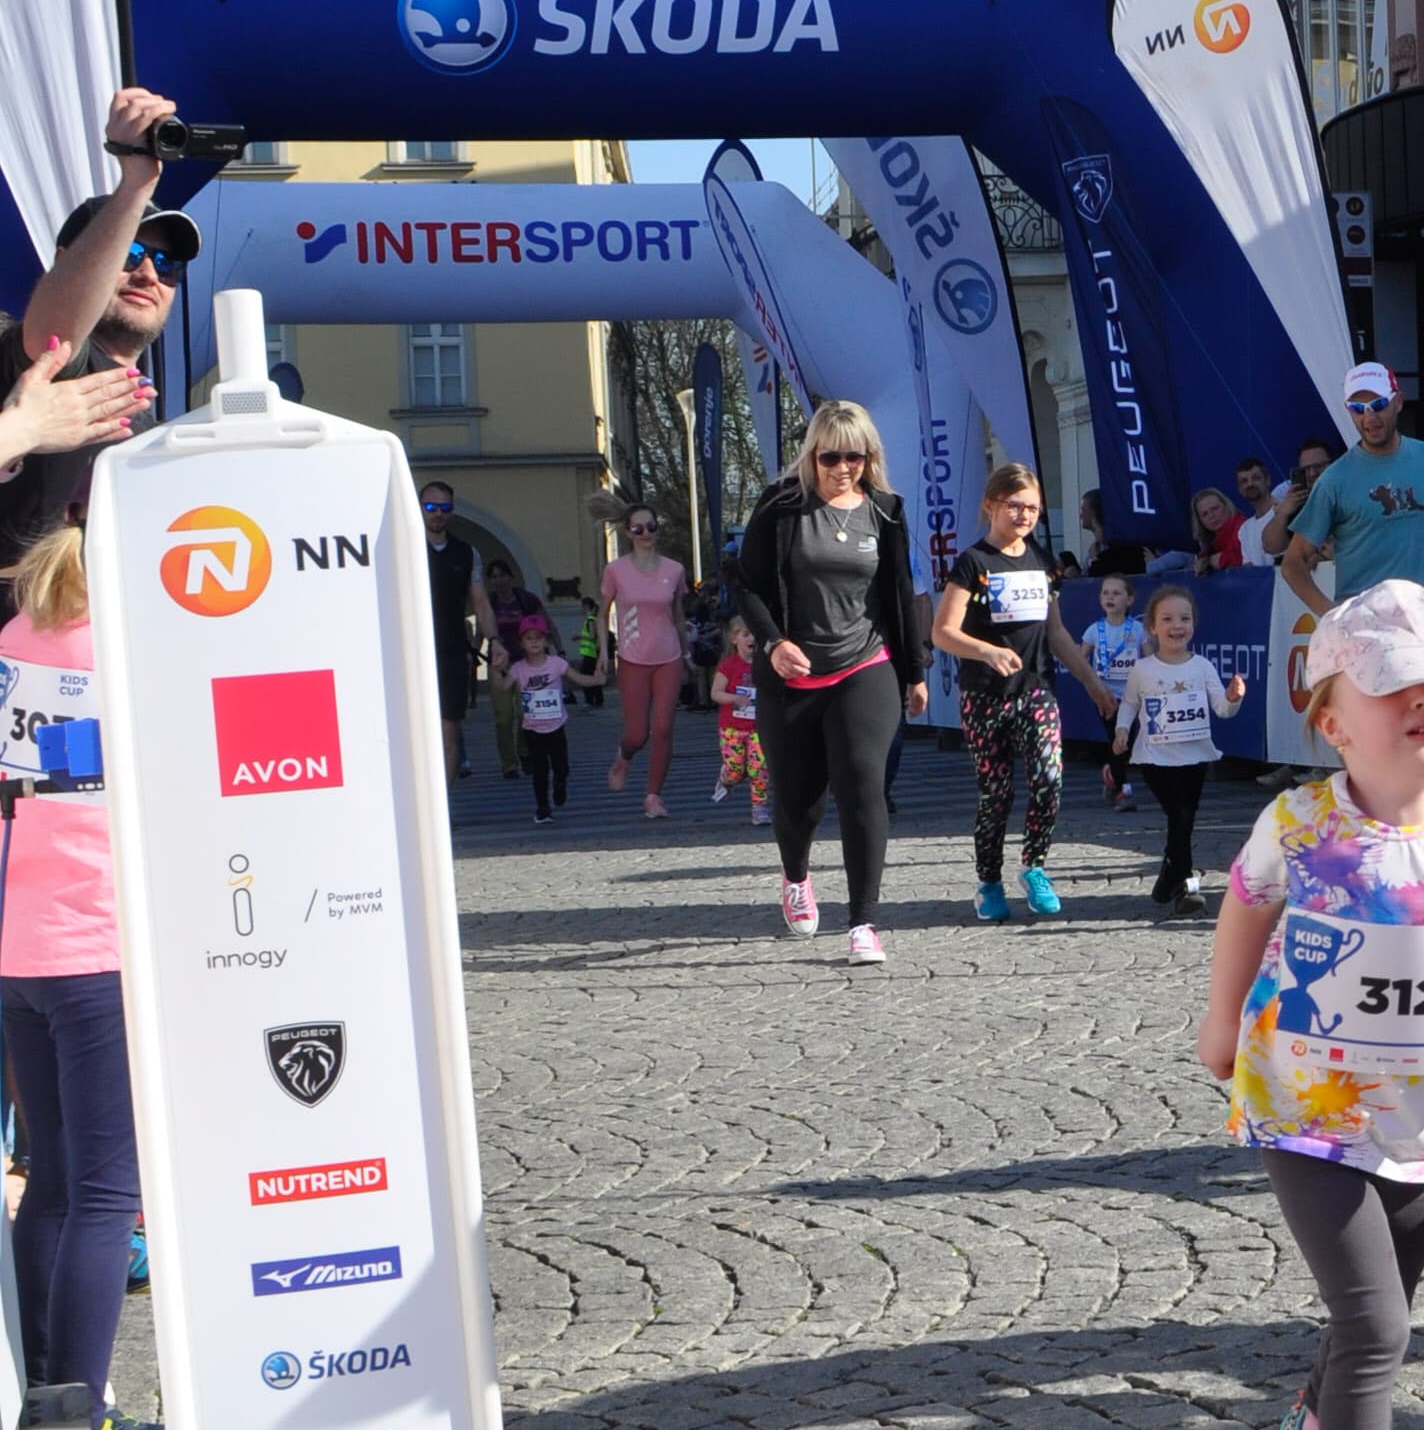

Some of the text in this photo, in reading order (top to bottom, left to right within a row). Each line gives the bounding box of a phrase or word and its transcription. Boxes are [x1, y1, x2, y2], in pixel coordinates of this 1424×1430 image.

[357, 219, 701, 265] INTERSPORT
[1086, 239, 1157, 515] PEUGEOT
[703, 386, 714, 460] gorenje
[292, 533, 371, 572] NN
[1011, 588, 1045, 601] 3253
[60, 674, 89, 686] KIDS
[59, 686, 84, 697] CUP
[1166, 706, 1206, 723] 3254
[232, 755, 329, 786] AVON
[328, 887, 384, 903] Powered
[328, 902, 384, 919] by MVM
[1295, 929, 1333, 950] KIDS
[206, 948, 288, 971] innogy
[1293, 946, 1327, 964] CUP
[271, 1027, 338, 1043] PEUGEOT
[257, 1165, 382, 1198] NUTREND
[308, 1344, 412, 1380] ŠKODA
